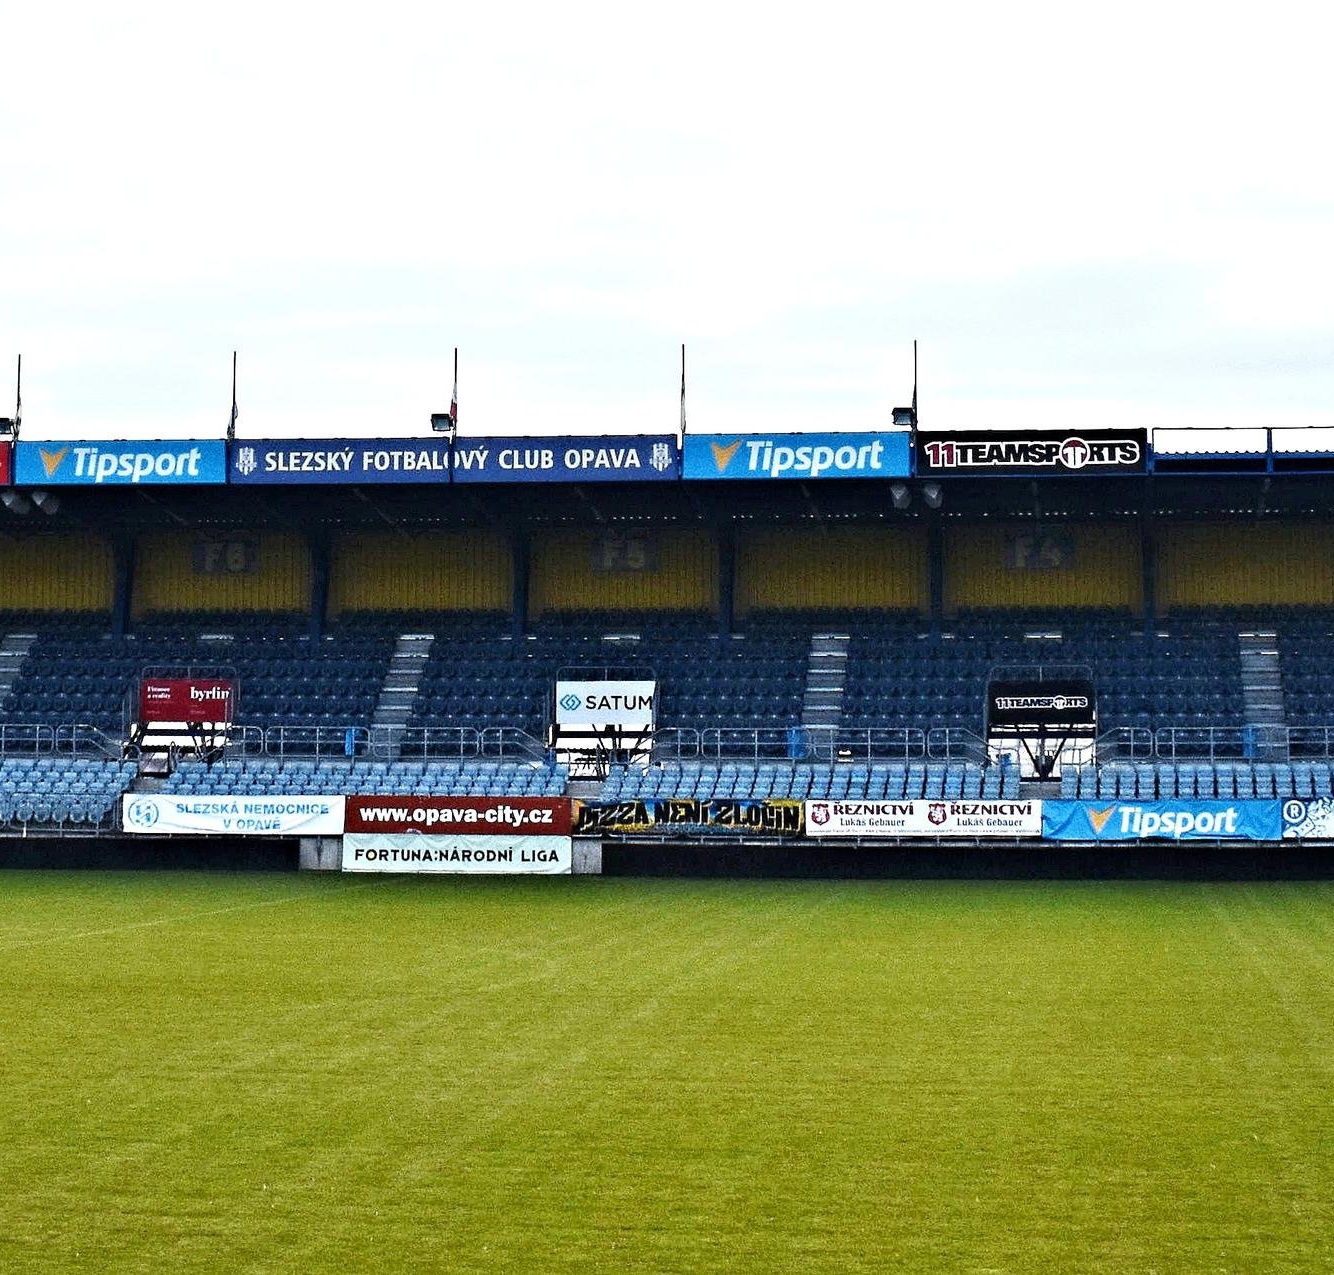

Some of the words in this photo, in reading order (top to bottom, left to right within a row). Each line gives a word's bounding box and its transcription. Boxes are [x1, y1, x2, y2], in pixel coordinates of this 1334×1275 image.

[264, 446, 354, 472] SLEZSKÝ
[363, 446, 489, 471] FOTBALOVÝ
[498, 448, 554, 470] CLUB
[564, 448, 641, 469] OPAVA
[746, 439, 884, 477] Tipsport
[925, 437, 1139, 469] 11TEAMSPORTS
[72, 446, 201, 483] Tipsport
[602, 540, 646, 569] F5
[585, 695, 653, 711] SATUM
[175, 801, 239, 815] SLEZSKÁ
[244, 803, 330, 815] NEMOCNICE
[359, 805, 553, 827] www.opava-city.cz
[833, 801, 914, 816] ŘEZNICTVÍ
[950, 801, 1032, 816] ŘEZNICTVÍ
[223, 819, 232, 829] V
[868, 817, 906, 827] Gebauer
[986, 817, 1023, 827] Gebauer
[1118, 806, 1238, 838] Tipsport
[521, 849, 560, 863] LIGA
